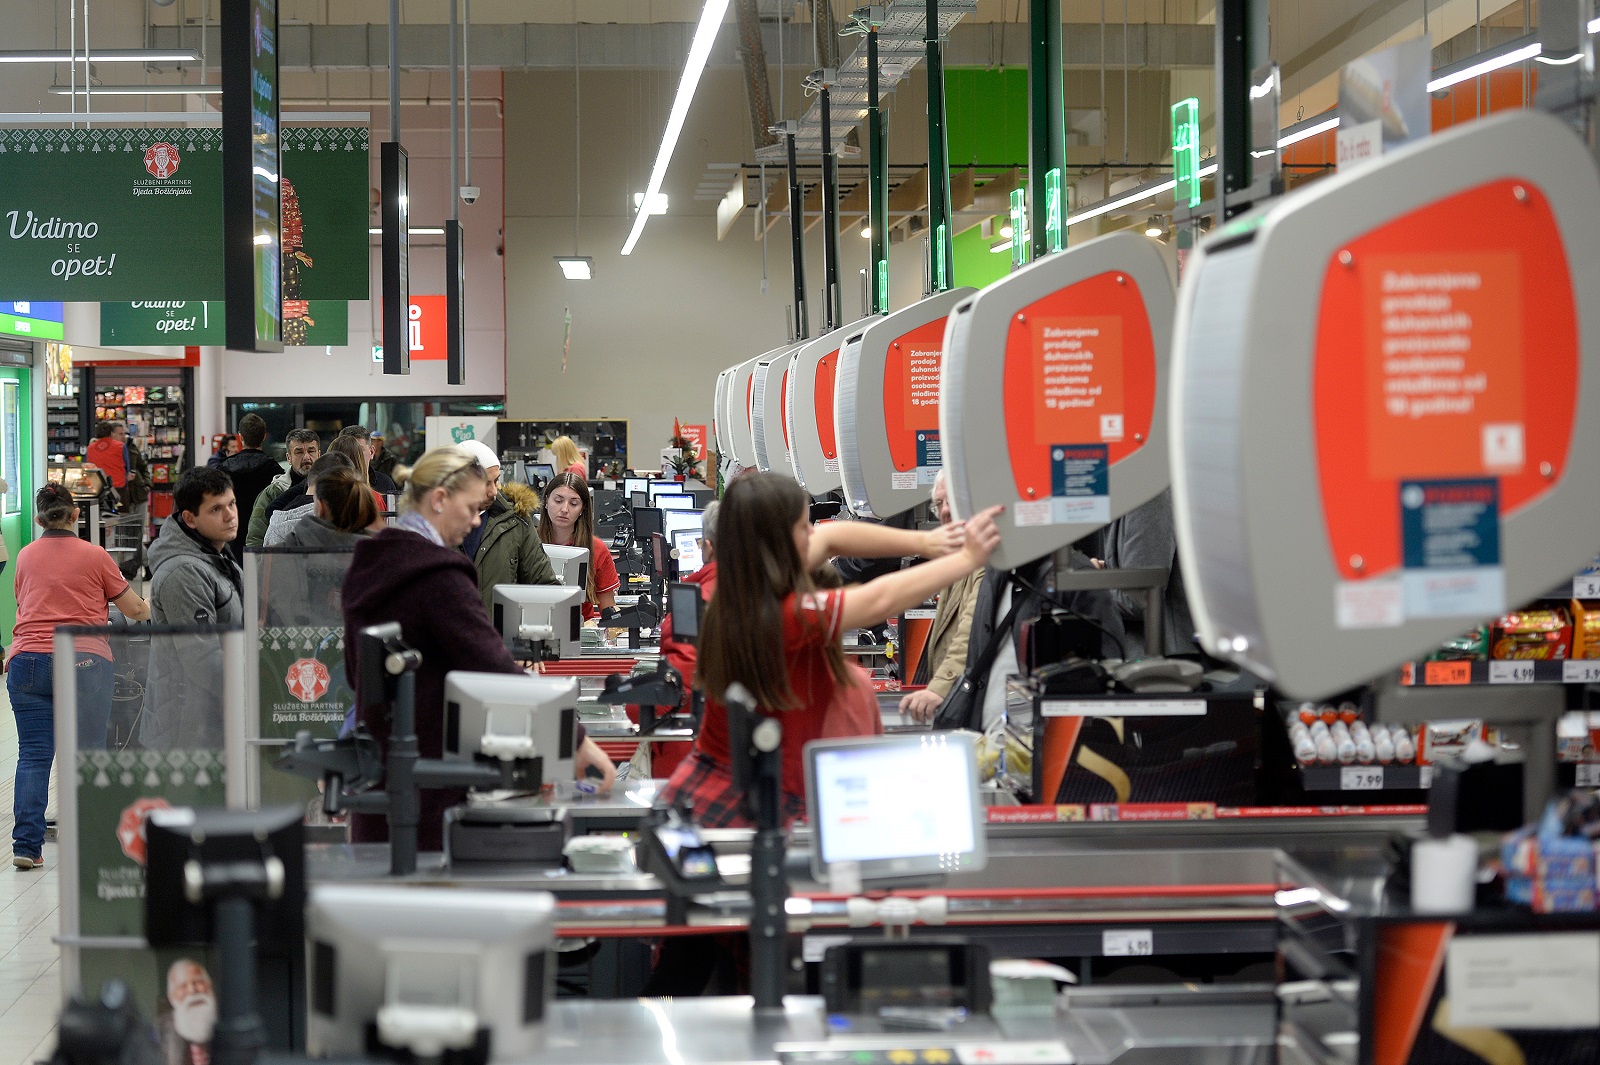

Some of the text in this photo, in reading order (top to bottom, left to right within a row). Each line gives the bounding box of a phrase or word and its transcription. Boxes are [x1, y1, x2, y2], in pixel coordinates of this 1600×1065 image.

[133, 188, 192, 197] Djeda Božićnjaka
[6, 210, 99, 239] Vidimo
[67, 243, 81, 254] SE
[50, 253, 117, 281] opet!
[156, 316, 196, 334] opet!
[1043, 327, 1099, 338] Zabranjena
[1043, 340, 1082, 351] prodaja
[1043, 350, 1094, 361] duhanskih
[911, 358, 937, 366] prodaja
[1043, 363, 1093, 375] proizvoda
[1044, 375, 1089, 385] osobama
[1088, 385, 1102, 396] od
[1045, 398, 1057, 408] 18
[1512, 667, 1534, 680] 4.99
[273, 702, 344, 710] SLUŽBENI PARTNER
[272, 712, 344, 724] Djeda Božićnjaka
[1356, 775, 1383, 788] 7.99
